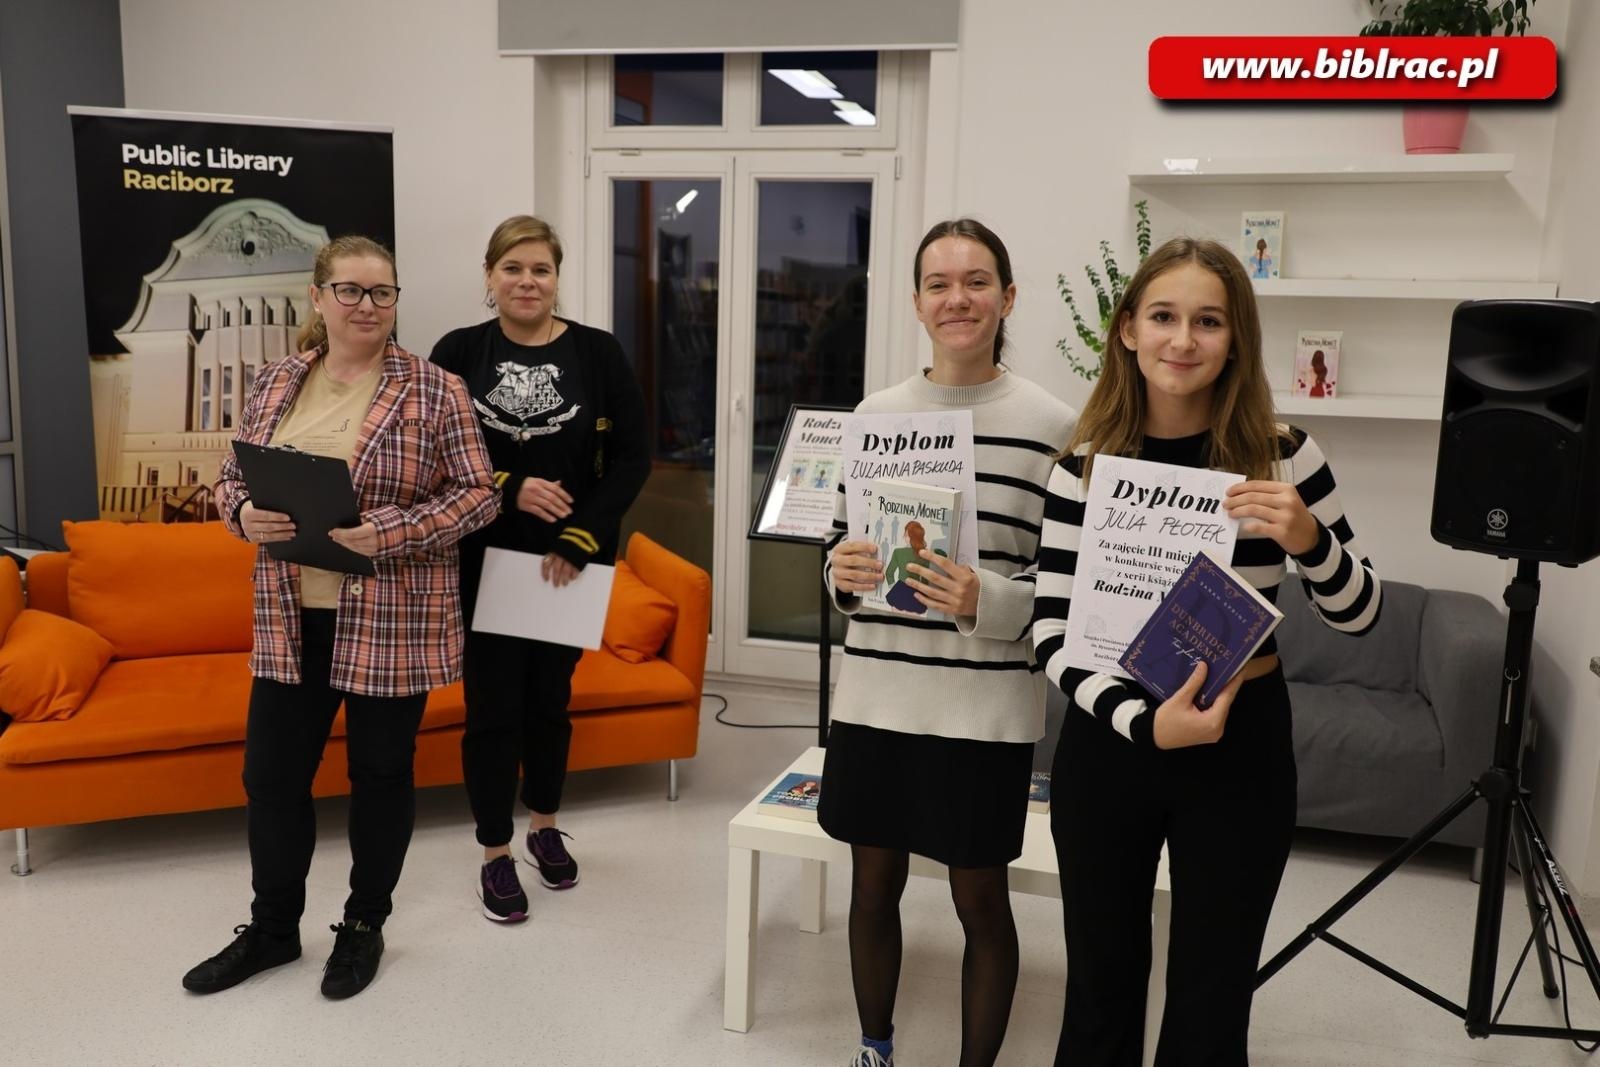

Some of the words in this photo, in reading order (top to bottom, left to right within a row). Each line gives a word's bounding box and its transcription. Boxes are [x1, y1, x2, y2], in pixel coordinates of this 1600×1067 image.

[122, 143, 201, 167] Public
[207, 147, 293, 177] Library
[123, 169, 234, 194] Raciborz
[800, 432, 842, 445] Monet
[862, 430, 955, 455] Dyplom
[850, 460, 910, 479] ZUZANNA
[911, 459, 963, 476] PASKUDA
[878, 496, 915, 515] RODZINA
[914, 502, 948, 521] MONET
[1111, 478, 1220, 514] Dyplom
[1094, 507, 1148, 532] JULIA
[1158, 516, 1227, 545] PŁOTEK
[1098, 539, 1110, 549] Za
[1112, 542, 1146, 555] zajęcie
[1147, 546, 1163, 558] III
[1115, 555, 1163, 571] konkursie
[1124, 571, 1145, 582] serii
[1094, 579, 1154, 601] Rodzina
[1168, 619, 1221, 664] ACADEMY
[1171, 603, 1232, 660] DUNBRIDGE
